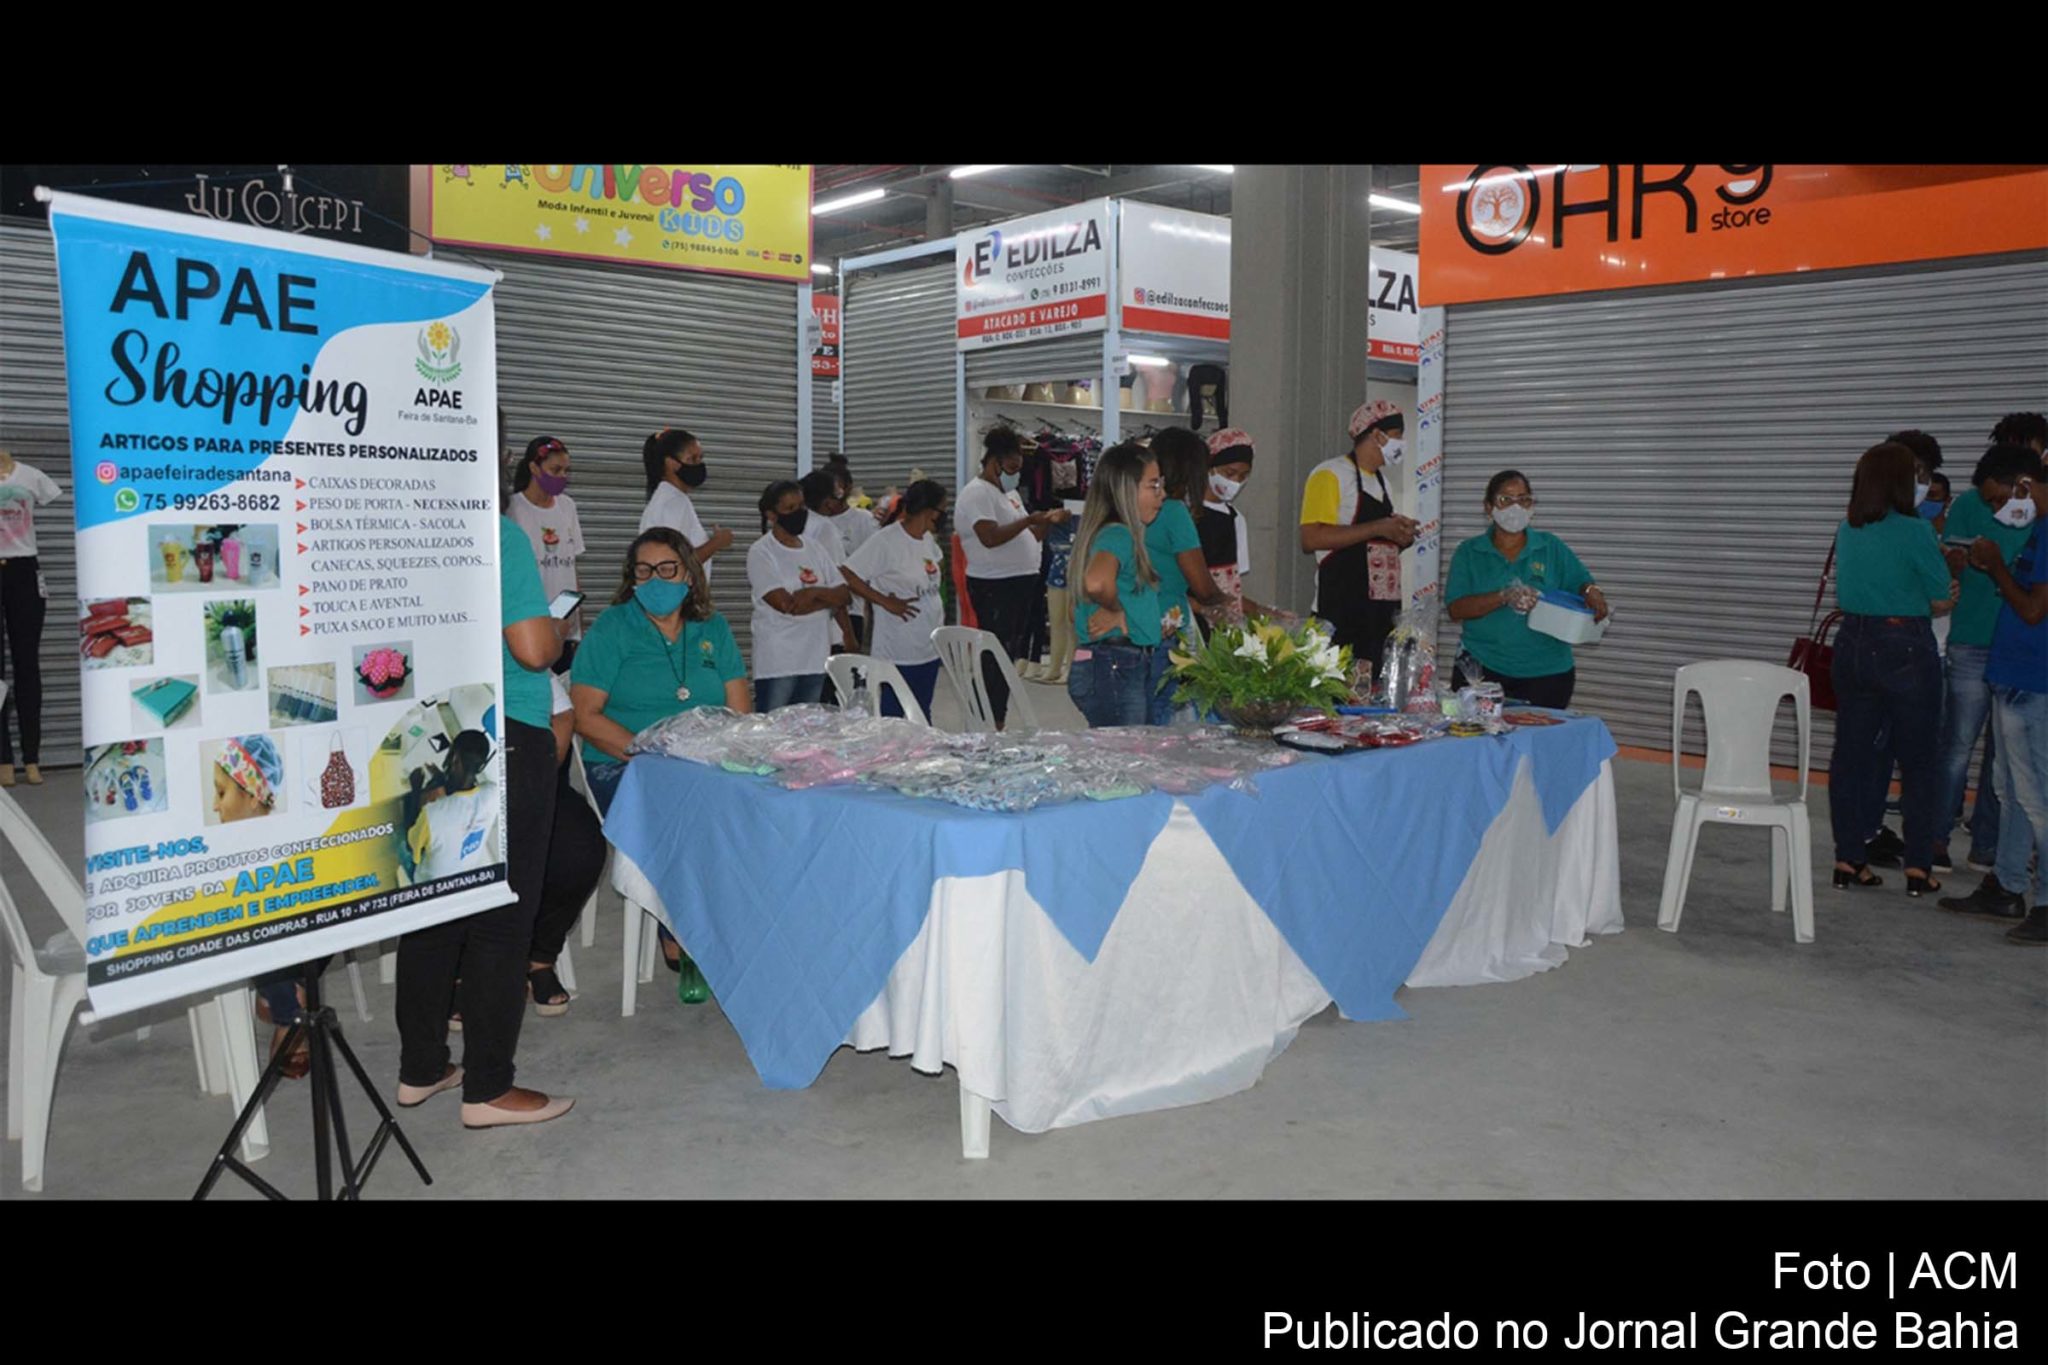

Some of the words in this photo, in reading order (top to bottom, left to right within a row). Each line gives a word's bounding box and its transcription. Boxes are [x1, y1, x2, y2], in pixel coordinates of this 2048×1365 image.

[537, 199, 569, 212] Moda
[570, 203, 608, 216] Infantil
[609, 210, 617, 218] e
[618, 210, 655, 222] Juvenil
[1711, 206, 1771, 231] store
[658, 208, 744, 242] KIDS
[1006, 219, 1101, 269] EDILZA
[110, 251, 318, 335] APAE
[983, 315, 1027, 330] ATACADO
[1030, 311, 1036, 323] E
[1040, 303, 1079, 321] VAREJO
[104, 329, 368, 436] Shopping
[414, 388, 463, 409] APAE
[398, 410, 419, 422] Feira
[420, 411, 431, 422] de
[100, 433, 188, 451] ARTIGOS
[194, 437, 244, 454] PARA
[249, 440, 345, 457] PRESENTES
[349, 445, 478, 462] PERSONALIZADOS
[119, 464, 292, 482] apaefeiradesantana
[309, 476, 358, 489] CAIXAS
[359, 478, 436, 490] DECORADAS
[143, 494, 167, 510] 75
[173, 493, 281, 510] 99263-8682
[309, 498, 342, 510] PESO
[344, 498, 363, 510] DE
[364, 498, 404, 510] PORTA
[413, 499, 491, 510] NECESSAIRE
[310, 518, 355, 531] BOLSA
[356, 515, 411, 530] TÉRMICA
[419, 518, 466, 530] SACOLA
[312, 538, 366, 552] ARTIGOS
[368, 537, 474, 550] PERSONALIZADOS
[311, 558, 375, 573] CANECAS,
[377, 556, 441, 571] SQUEEZES,
[312, 580, 347, 593] PANO
[349, 579, 367, 592] DE
[369, 577, 408, 590] PRATO
[313, 600, 357, 614] TOUCA
[359, 598, 368, 611] E
[369, 596, 424, 611] AVENTAL
[314, 621, 349, 635] PUXA
[351, 618, 385, 632] SACO
[387, 616, 396, 629] E
[397, 613, 437, 628] MUITO
[100, 866, 183, 895] ADQUIRA
[184, 848, 269, 876] PRODUTOS
[271, 823, 394, 859] CONFECCIONADOS
[86, 902, 119, 923] POR
[126, 886, 195, 913] JOVENS
[201, 881, 226, 896] DA
[232, 857, 314, 897] APAE
[86, 929, 130, 956] QUE
[133, 904, 243, 943] APRENDEM
[248, 901, 260, 917] E
[106, 949, 174, 976] SHOPPING
[177, 938, 223, 959] CIDADE
[226, 931, 250, 948] DAS
[252, 916, 309, 941] COMPRAS
[316, 910, 339, 924] RUA
[341, 904, 352, 917] 10
[372, 897, 388, 911] 732
[389, 889, 421, 908] (FEIRA
[421, 885, 435, 897] DE
[435, 869, 495, 895] SANTANA-BA)
